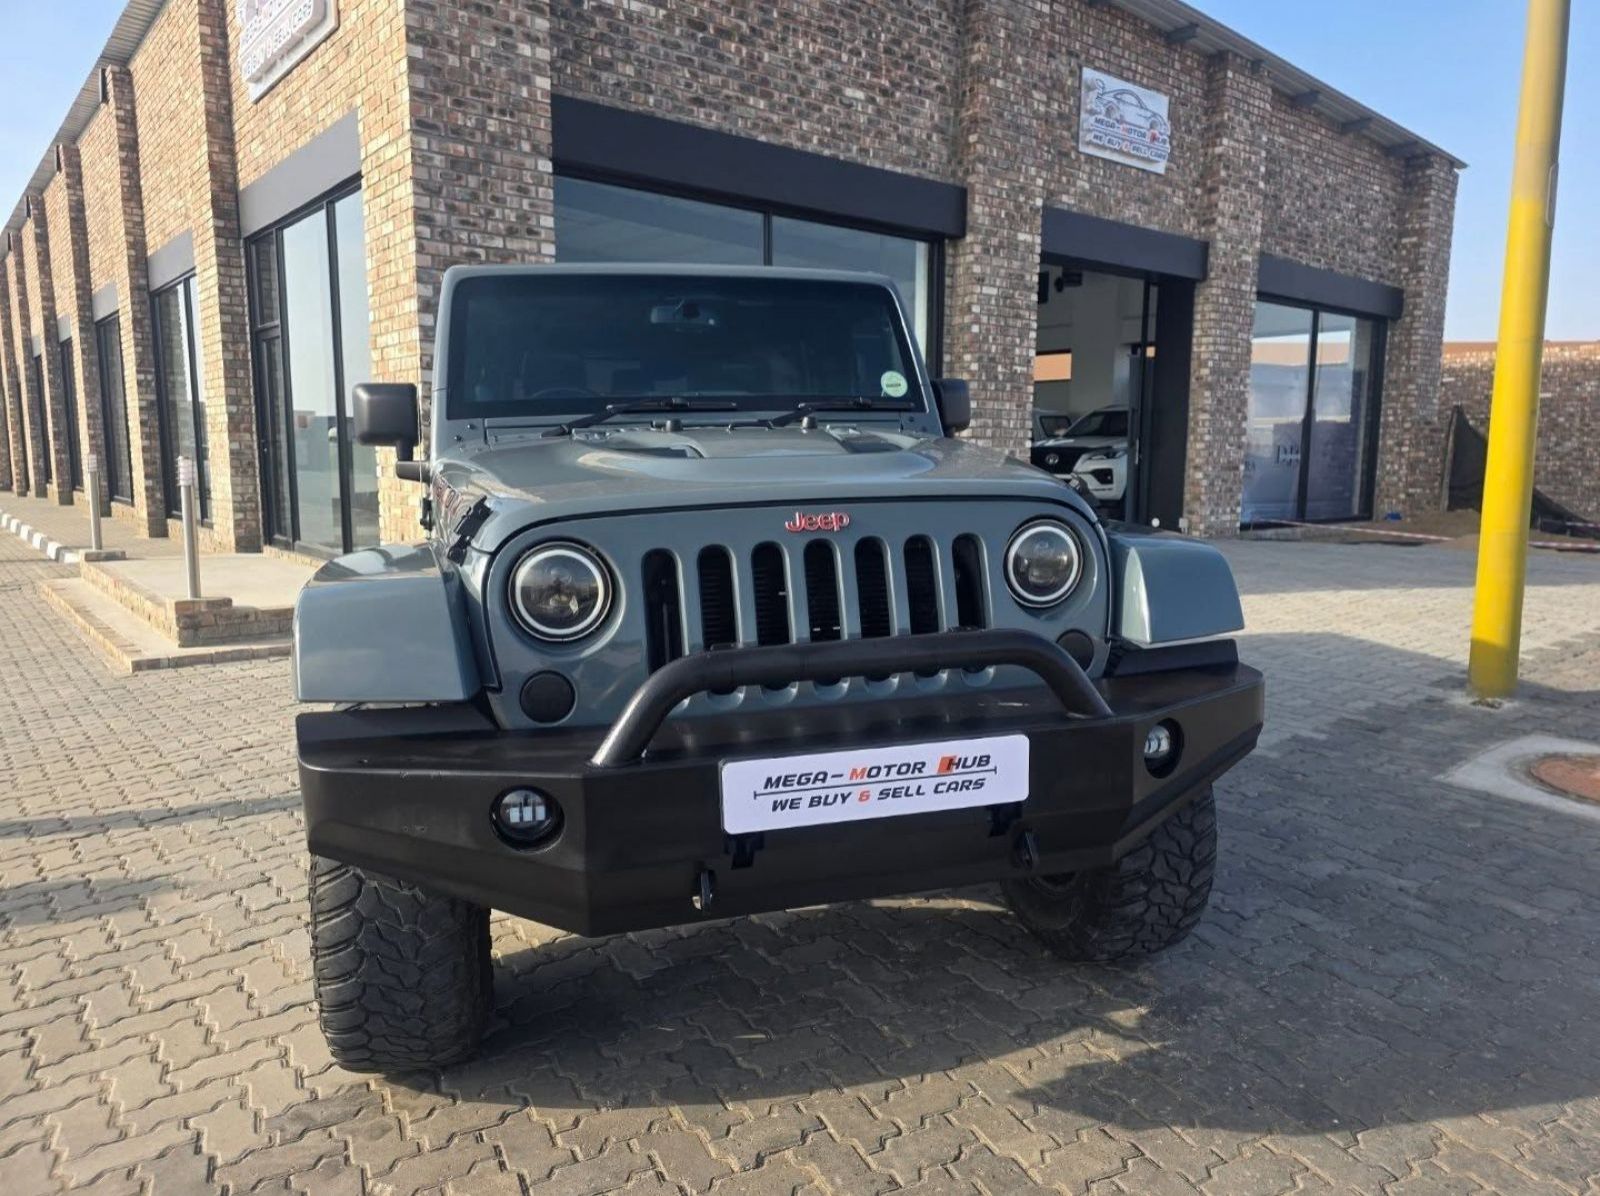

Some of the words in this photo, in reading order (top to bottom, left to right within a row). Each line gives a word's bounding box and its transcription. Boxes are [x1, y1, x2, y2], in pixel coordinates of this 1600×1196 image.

[785, 511, 850, 532] Jeep
[849, 761, 927, 780] MOTOR
[946, 754, 991, 771] HUB
[771, 797, 803, 812] WE
[807, 792, 852, 808] BUY
[878, 785, 926, 800] SELL
[933, 778, 987, 794] CARS
